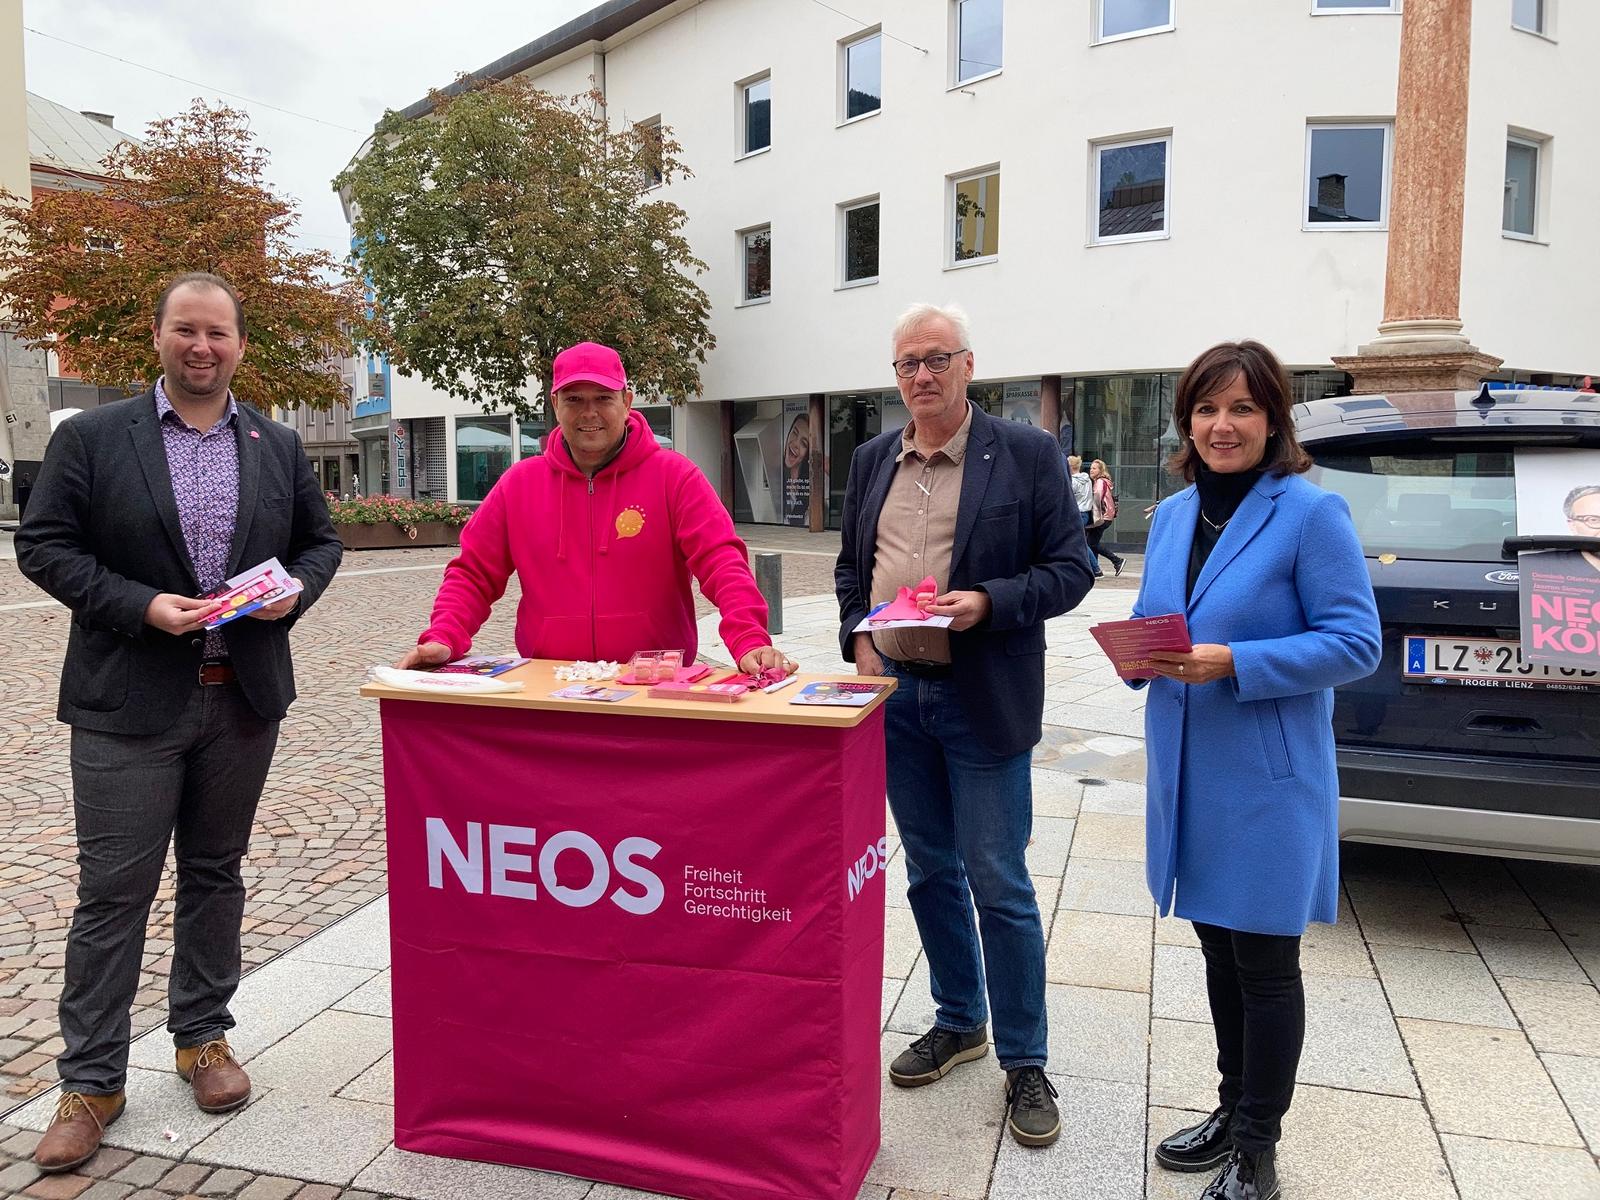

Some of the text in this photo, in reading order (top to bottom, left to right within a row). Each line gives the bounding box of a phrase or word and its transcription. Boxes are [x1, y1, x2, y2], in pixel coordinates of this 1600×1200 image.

[1531, 594, 1600, 624] NE
[1145, 618, 1170, 626] NEOS
[1532, 621, 1600, 656] KÖ
[1459, 678, 1534, 689] TROGER LIENZ
[425, 816, 665, 916] NEOS
[684, 865, 743, 885] Freiheit
[684, 882, 766, 904] Fortschritt
[684, 899, 792, 923] Gerechtigkeit
